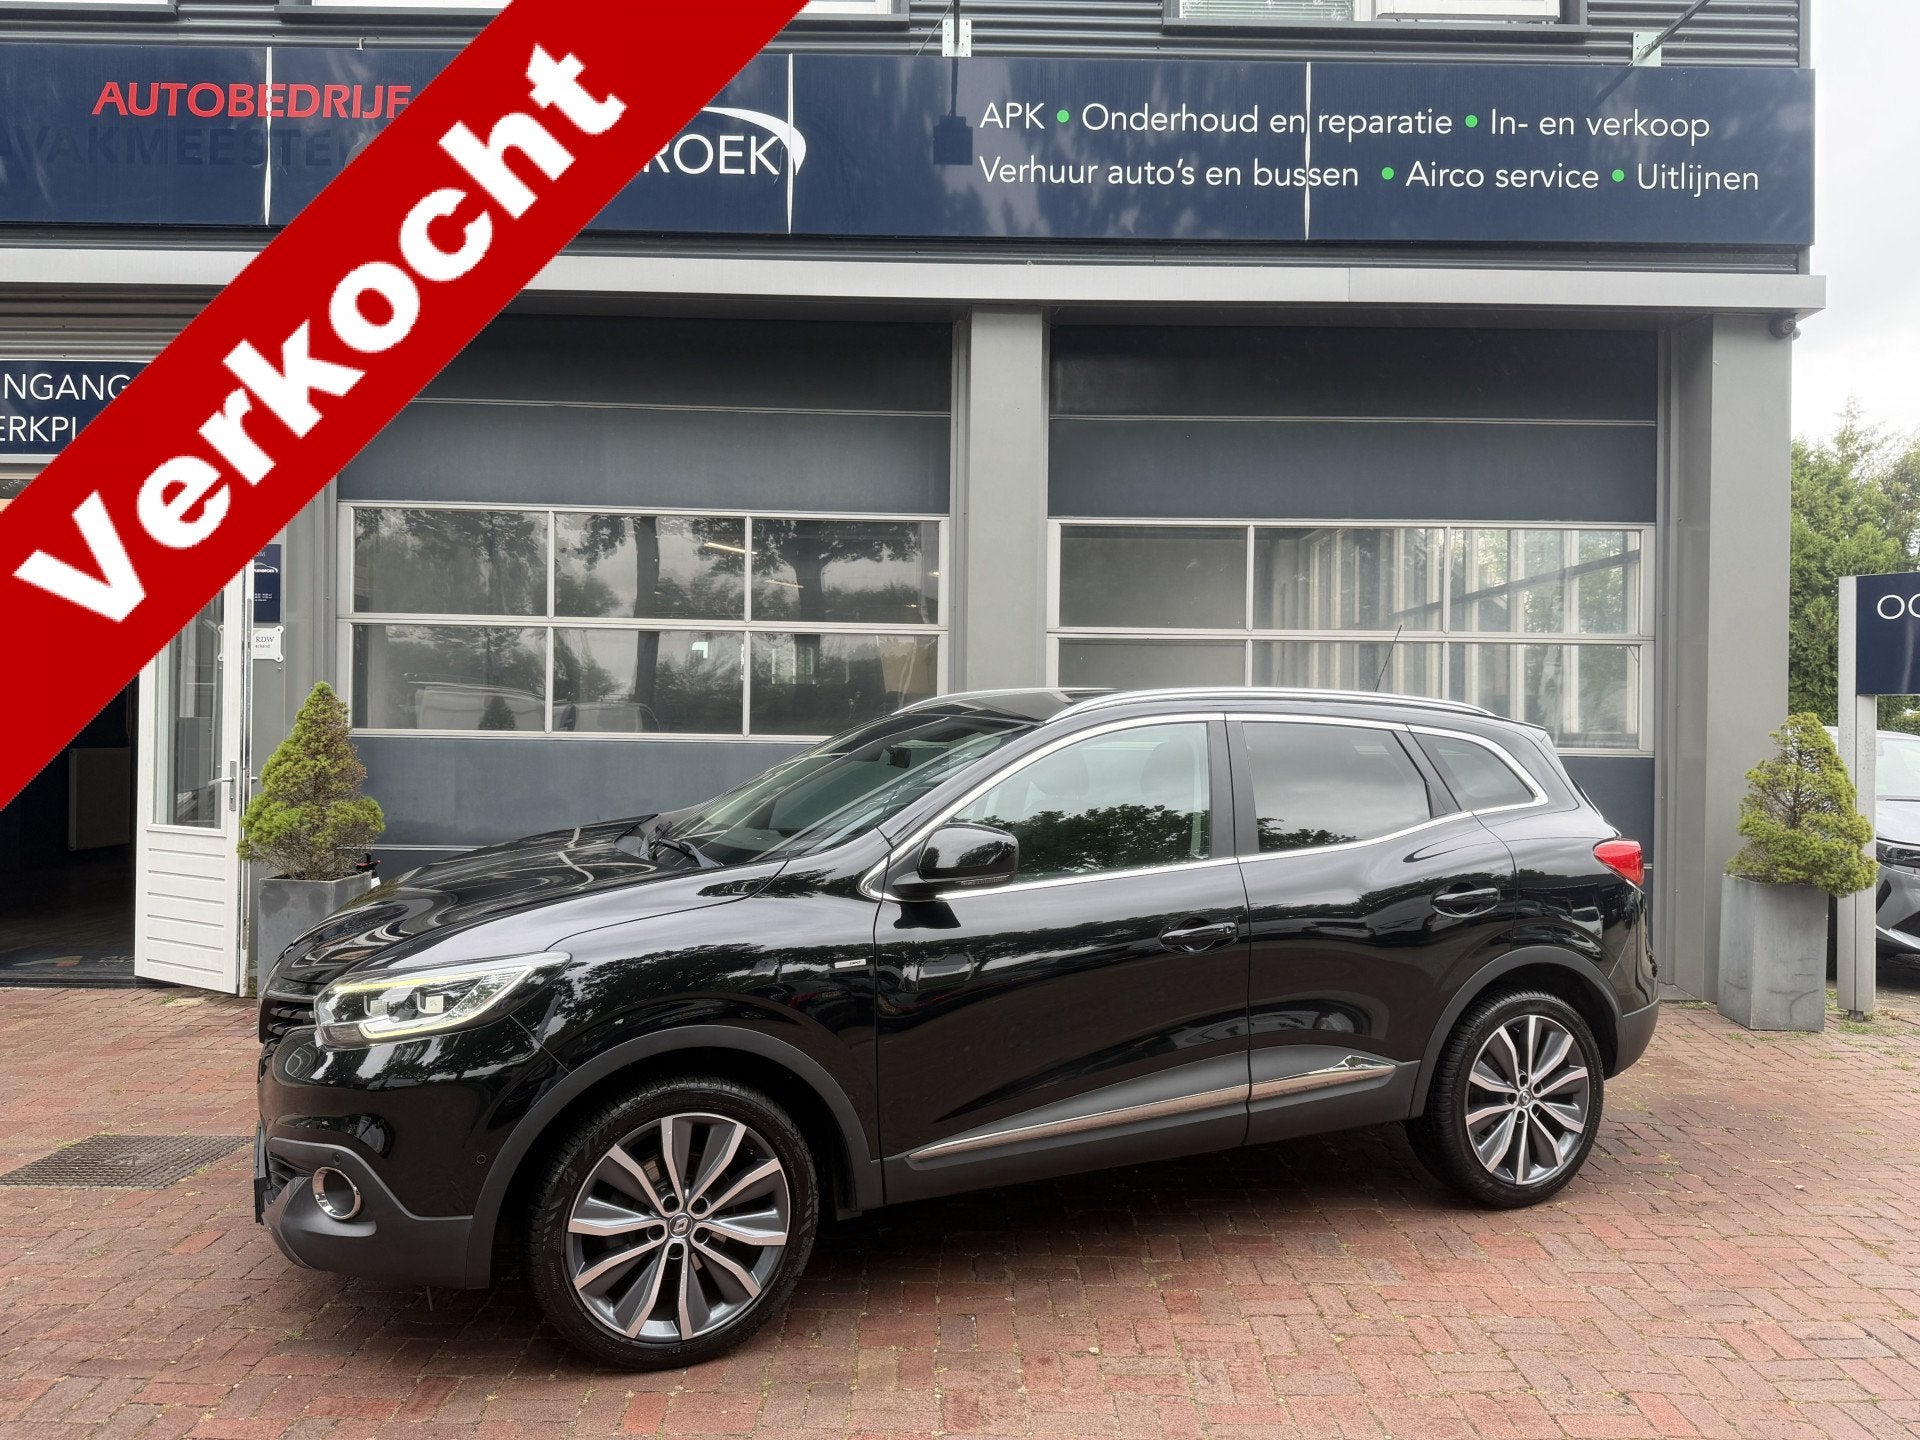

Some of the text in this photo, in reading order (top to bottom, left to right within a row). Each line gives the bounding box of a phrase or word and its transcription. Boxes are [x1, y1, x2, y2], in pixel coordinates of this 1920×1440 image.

[92, 82, 411, 119] AUTOBEDRIJF
[979, 102, 1710, 147] APK Onderhoud en reparatie In- en verkoop
[978, 154, 1759, 198] Verhuur auto's en bussen Airco service Uitlijnen
